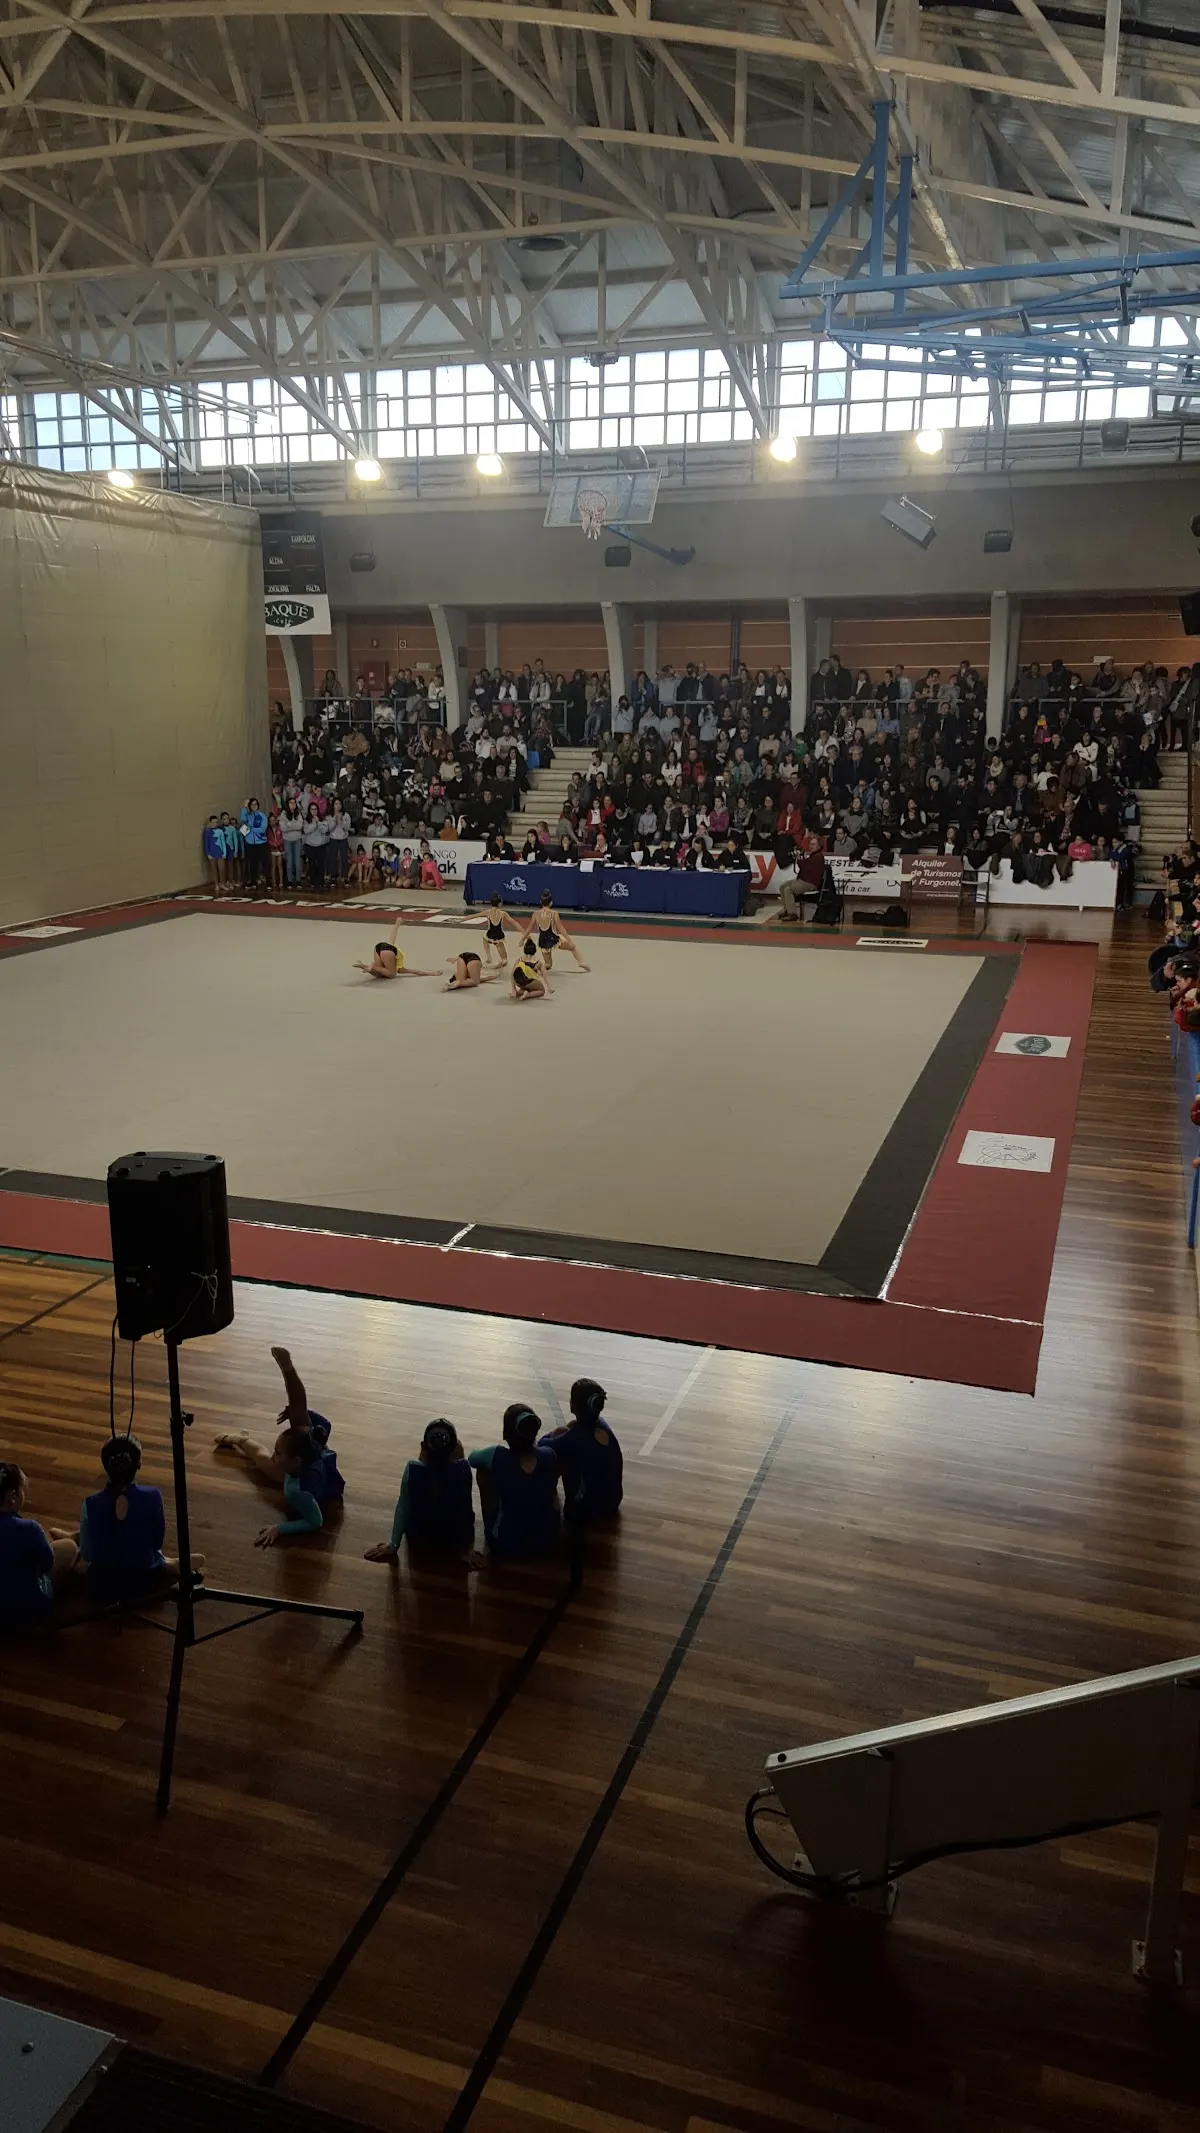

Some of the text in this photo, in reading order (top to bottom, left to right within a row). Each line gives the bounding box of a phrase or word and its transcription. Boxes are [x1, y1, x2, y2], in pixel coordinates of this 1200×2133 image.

[911, 859, 947, 868] Alquiler
[910, 869, 962, 878] de Turismos
[919, 878, 961, 888] Furgonet
[174, 894, 443, 914] DURANGO
